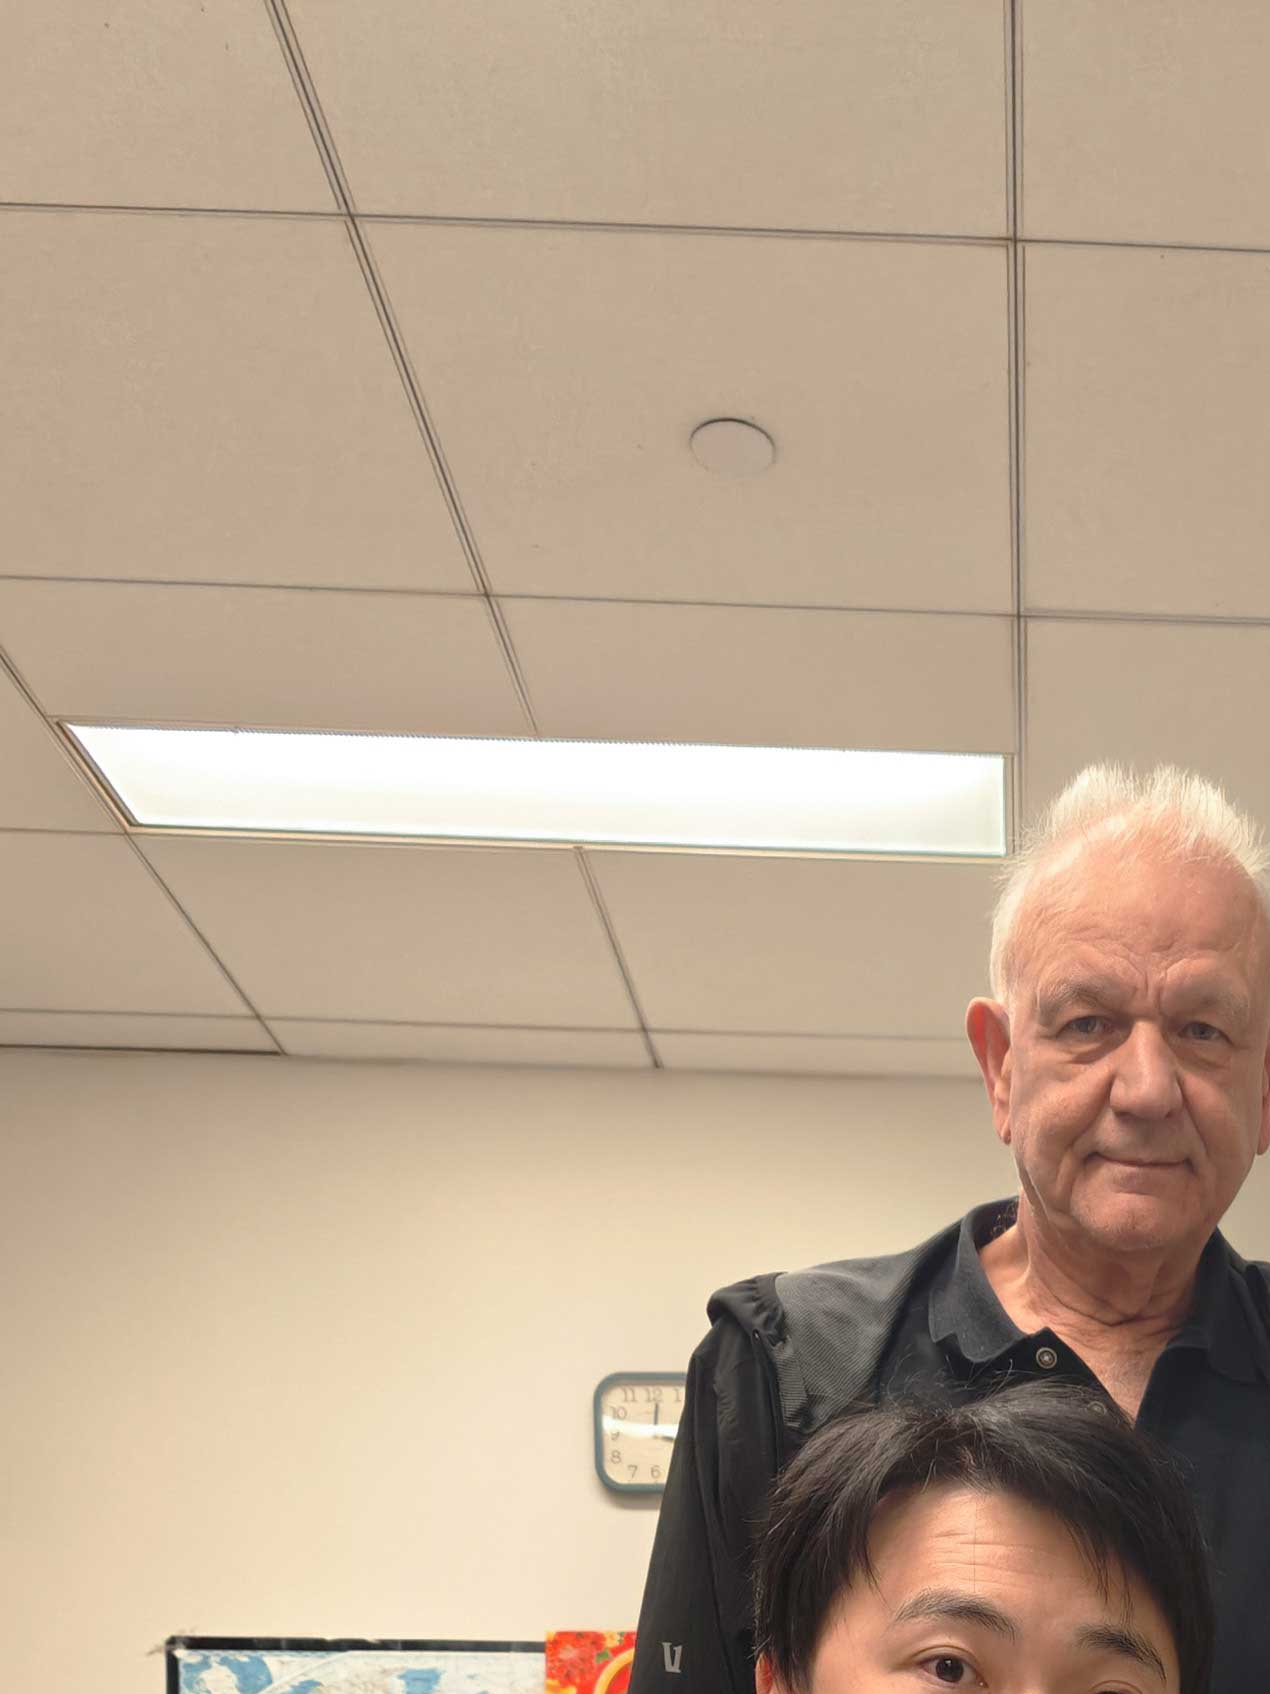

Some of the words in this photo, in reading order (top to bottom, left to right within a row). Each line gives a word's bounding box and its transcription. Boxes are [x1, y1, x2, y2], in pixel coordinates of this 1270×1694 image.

[621, 1387, 637, 1402] 11
[644, 1387, 663, 1402] 12
[610, 1406, 628, 1420] 10
[611, 1450, 621, 1464] 8
[627, 1464, 638, 1478] 7
[650, 1465, 660, 1479] 6
